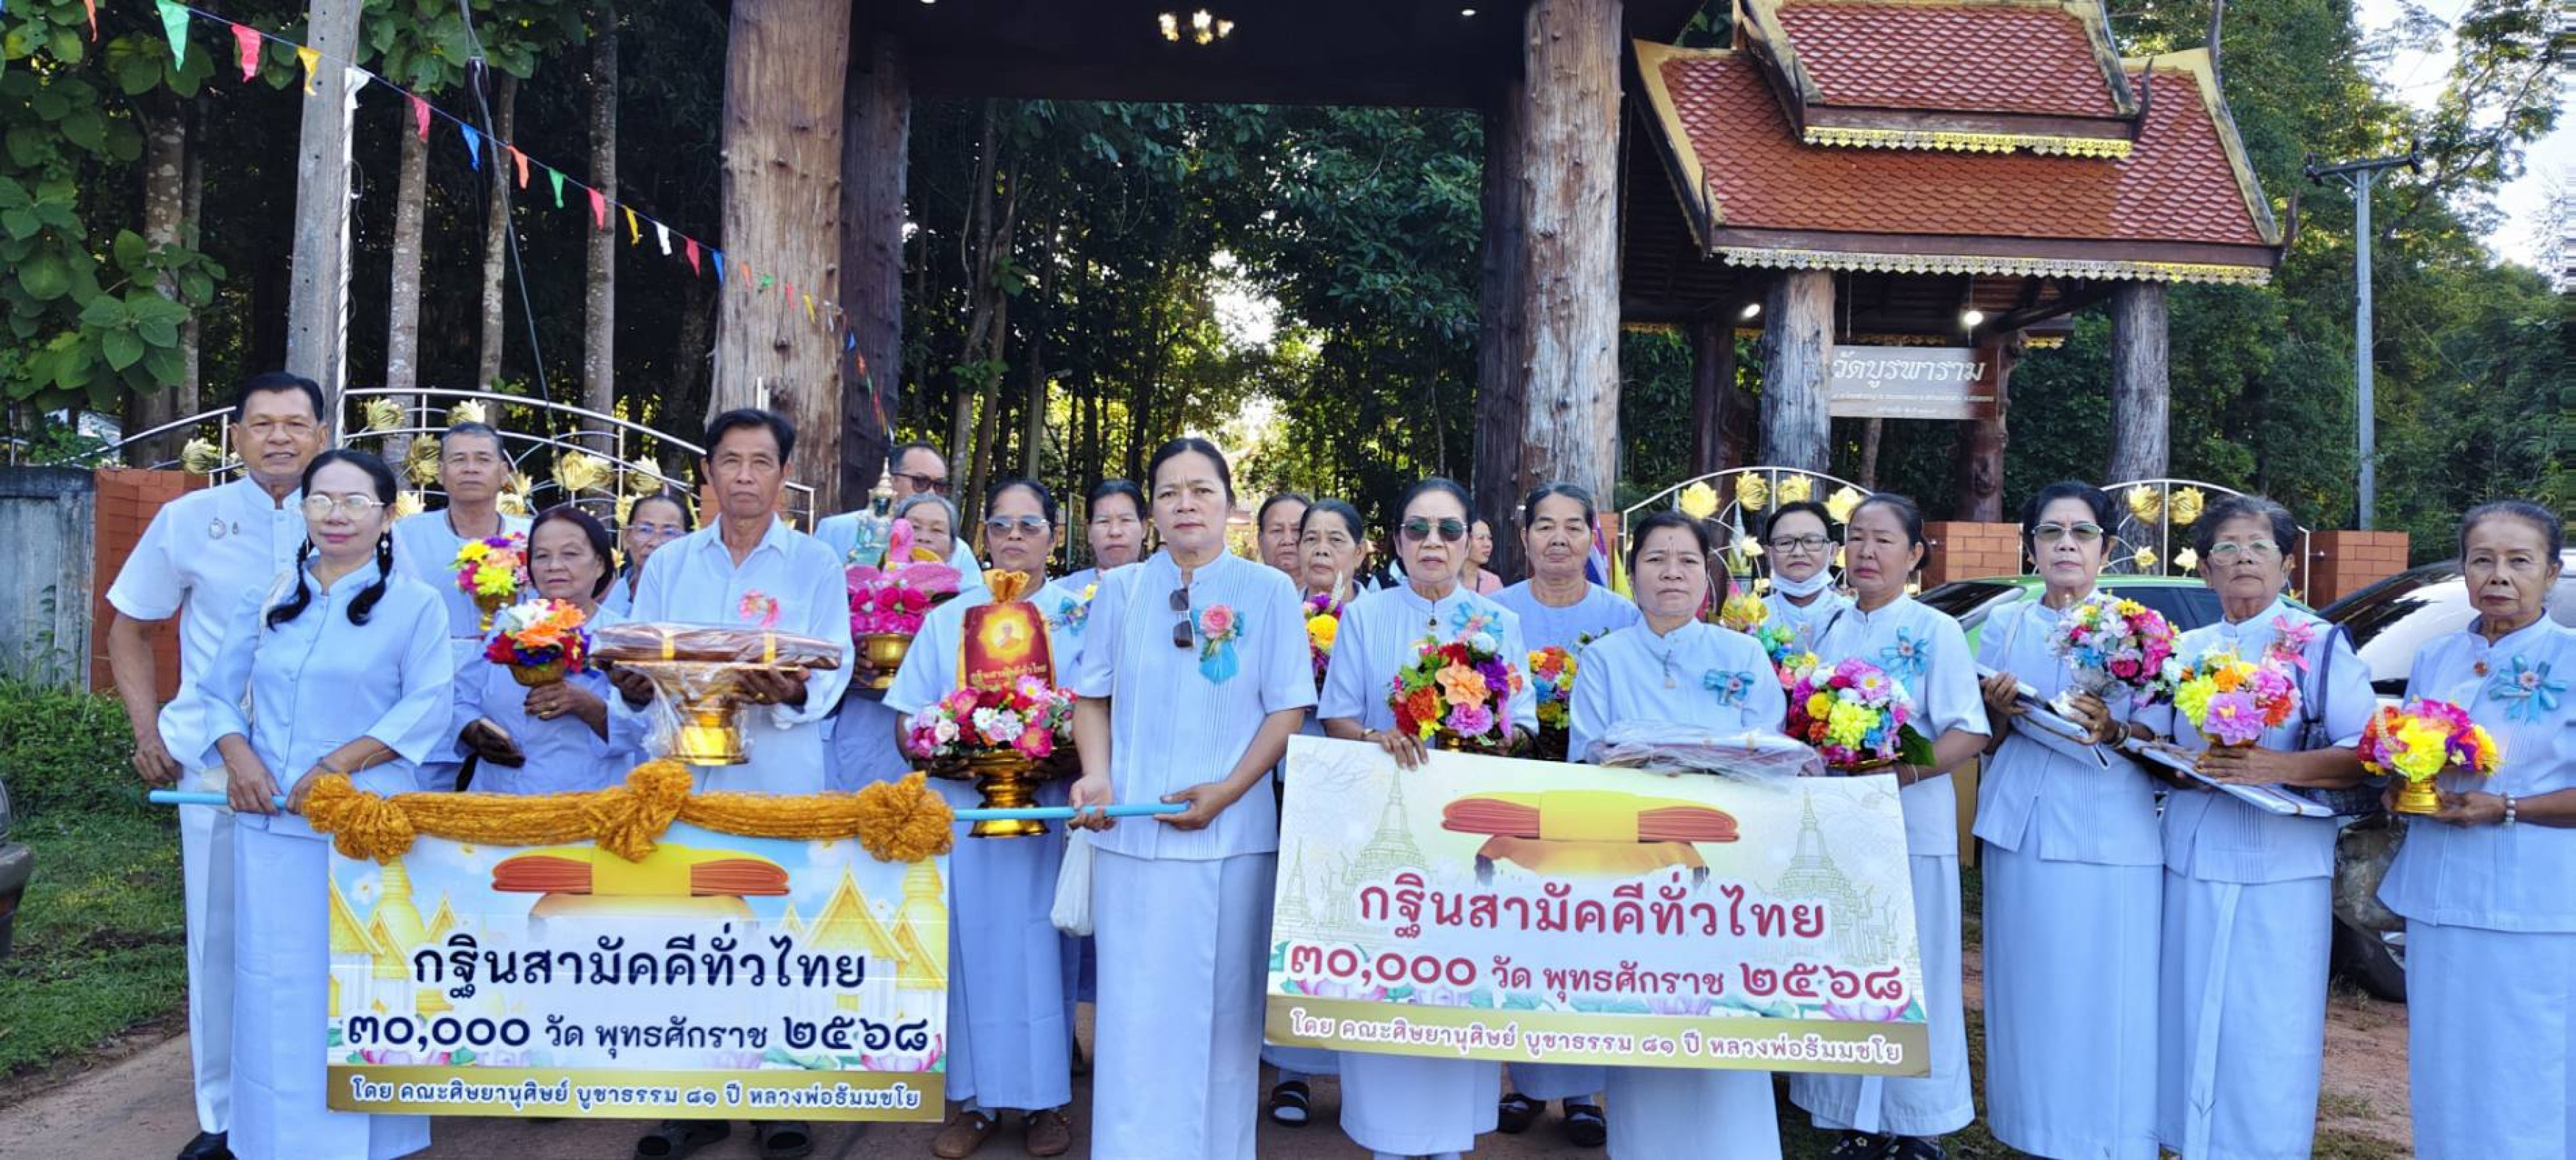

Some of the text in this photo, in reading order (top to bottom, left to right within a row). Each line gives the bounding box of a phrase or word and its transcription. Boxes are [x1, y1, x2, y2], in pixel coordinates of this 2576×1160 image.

[1833, 351, 1986, 389] วัดบูรพาราม
[1360, 871, 1824, 938] กฐินสามัคคีทั่วไทย
[414, 922, 866, 998] กฐินสามัคคีทั่วไทย
[1290, 945, 1903, 1003] ๓๐,๐๐๐ วัด พุทธศักราช ๒๕๖๘
[348, 1014, 928, 1058] ๓๐,๐๐๐ วัด พุทธศักราช ๒๕๖๘
[1292, 1011, 1332, 1035] โดย
[1343, 1019, 1516, 1053] คณะศิษยานุศิษย์
[1526, 1033, 1632, 1056] บูชาธรรม
[1642, 1037, 1674, 1053] ๘๑
[1684, 1031, 1699, 1054] ปี
[352, 1077, 392, 1099] โดย
[402, 1080, 570, 1108] คณะศิษยานุศิษย์
[578, 1086, 678, 1109] บูชาธรรม
[687, 1090, 717, 1103] ๘๑
[727, 1083, 740, 1104] ปี
